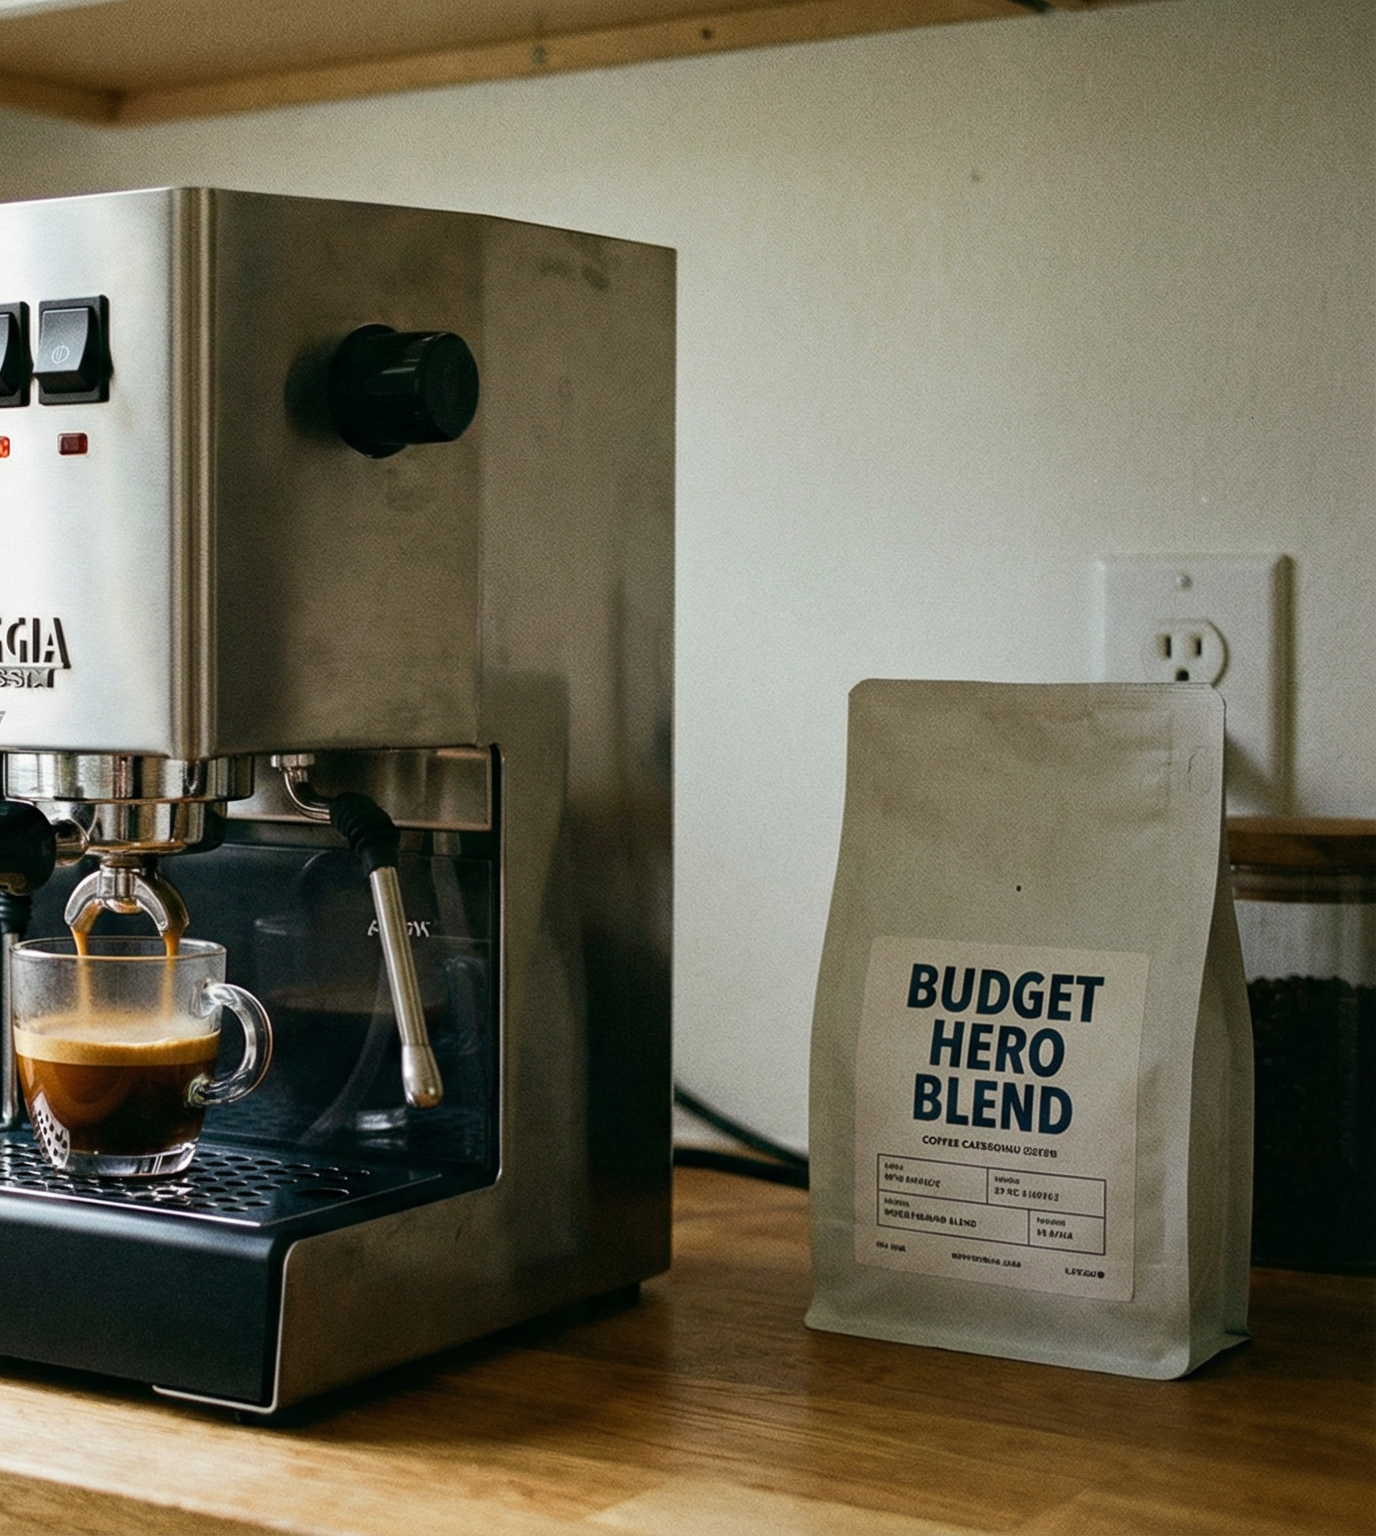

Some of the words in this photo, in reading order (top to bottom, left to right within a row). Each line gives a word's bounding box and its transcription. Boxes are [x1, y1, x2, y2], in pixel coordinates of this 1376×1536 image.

[906, 963, 1105, 1023] BUDGET
[929, 1018, 1065, 1078] HERO
[912, 1072, 1073, 1135] BLEND
